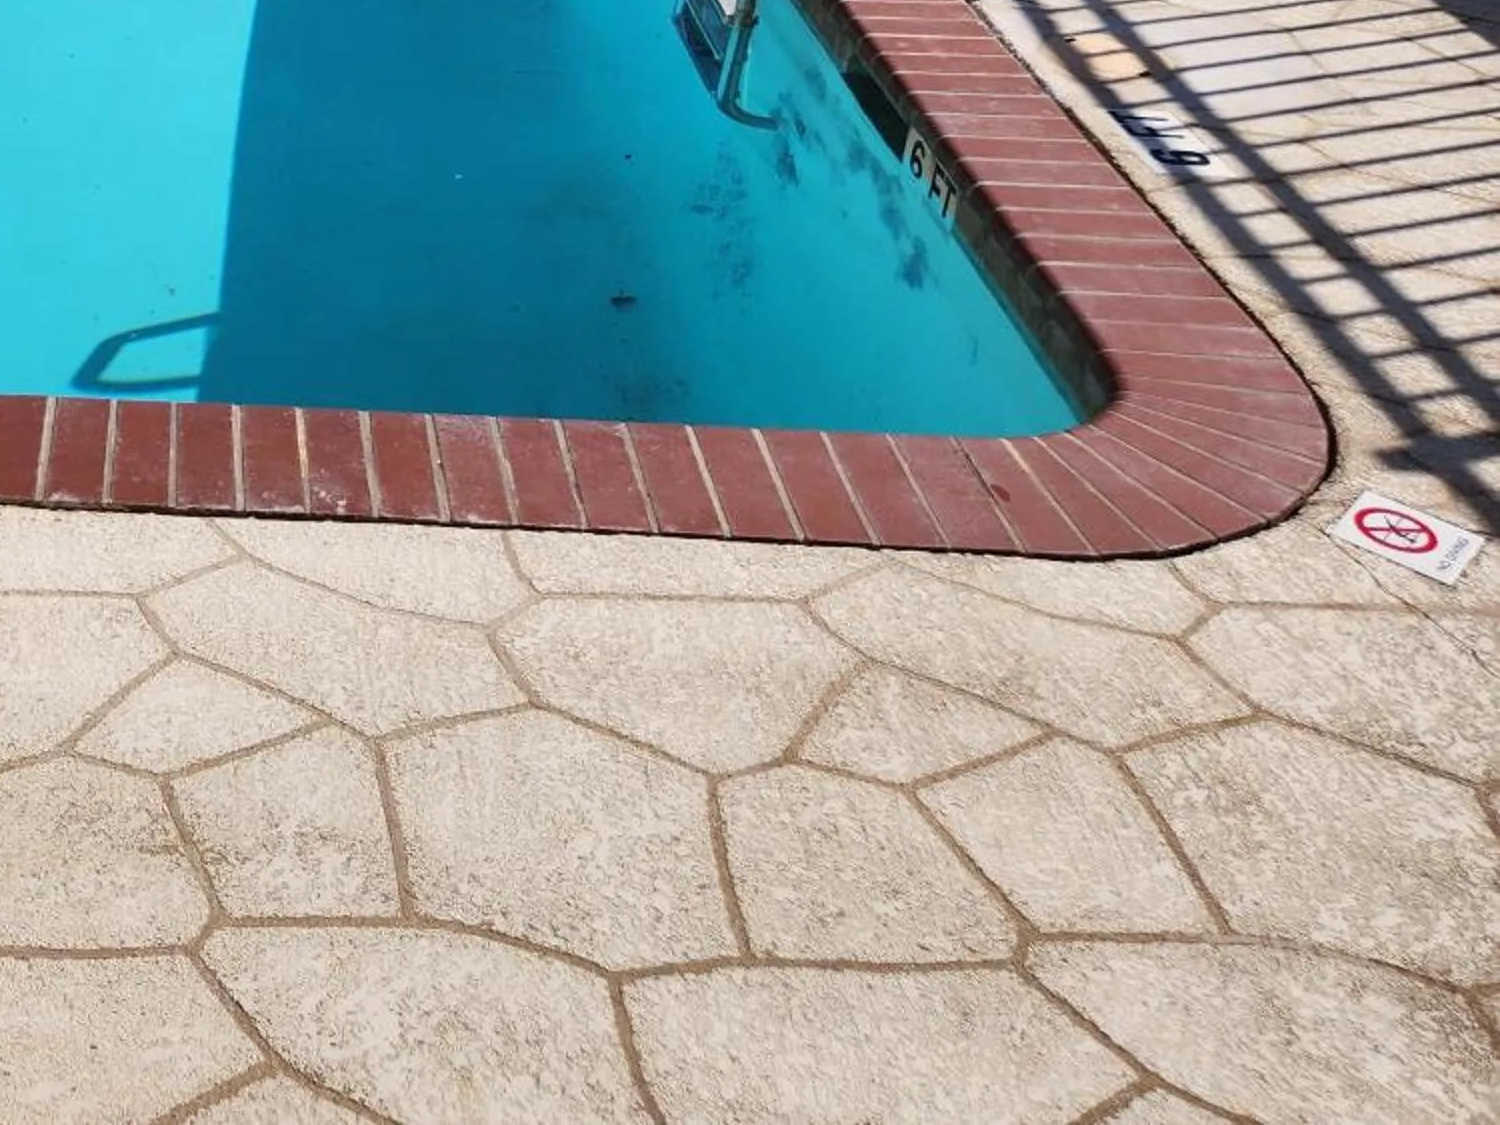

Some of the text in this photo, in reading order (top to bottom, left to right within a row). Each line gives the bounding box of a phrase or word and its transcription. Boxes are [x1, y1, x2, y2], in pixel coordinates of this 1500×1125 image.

[1107, 110, 1210, 166] 6 FT
[910, 139, 957, 218] 6 FT
[1436, 536, 1470, 573] NO DIVING
